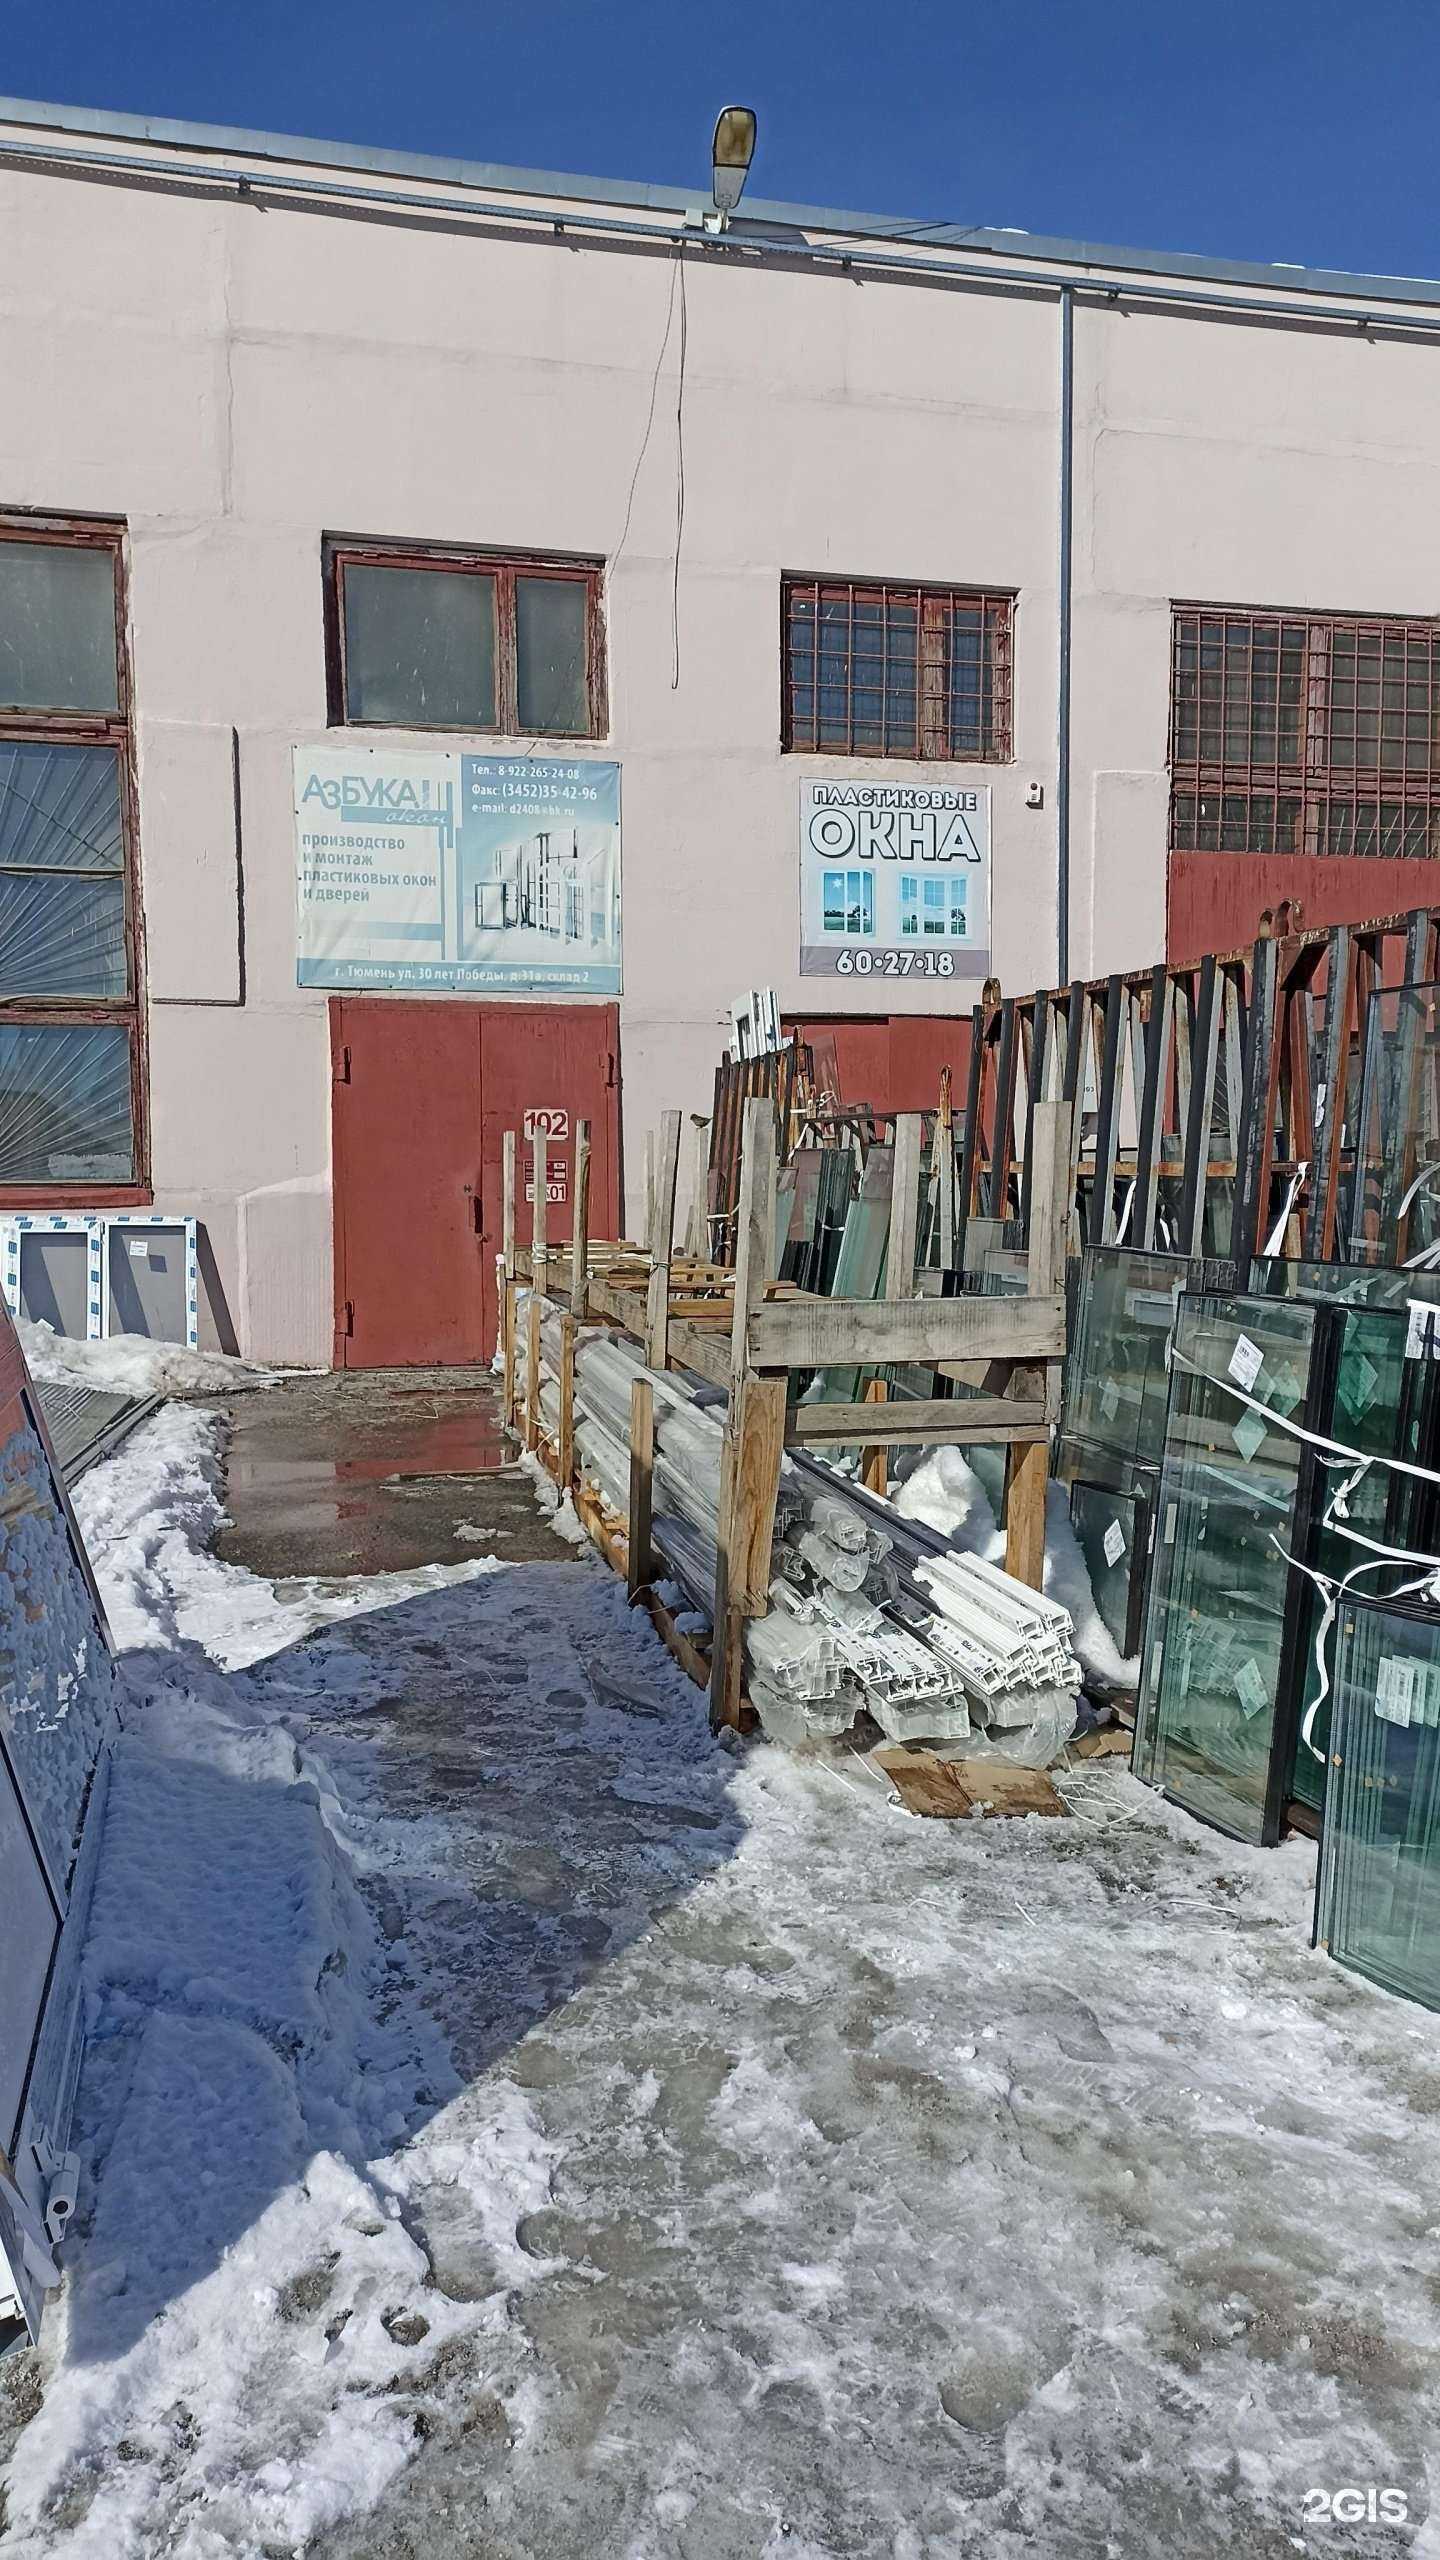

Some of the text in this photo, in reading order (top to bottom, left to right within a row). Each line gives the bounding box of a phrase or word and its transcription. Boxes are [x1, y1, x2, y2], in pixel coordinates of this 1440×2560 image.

[502, 783, 598, 801] (3452)35-42-96
[812, 785, 977, 811] ПЛАСТИКОВЫЕ
[302, 833, 405, 850] производство
[809, 808, 982, 863] ОКНА
[303, 853, 373, 866] и монтаж
[303, 869, 437, 887] пластиковых окон
[303, 887, 370, 904] и дверей
[347, 965, 395, 979] Тюмень
[419, 967, 432, 979] 30
[434, 970, 454, 980] лет
[583, 971, 589, 983] 2
[525, 1112, 567, 1136] 102
